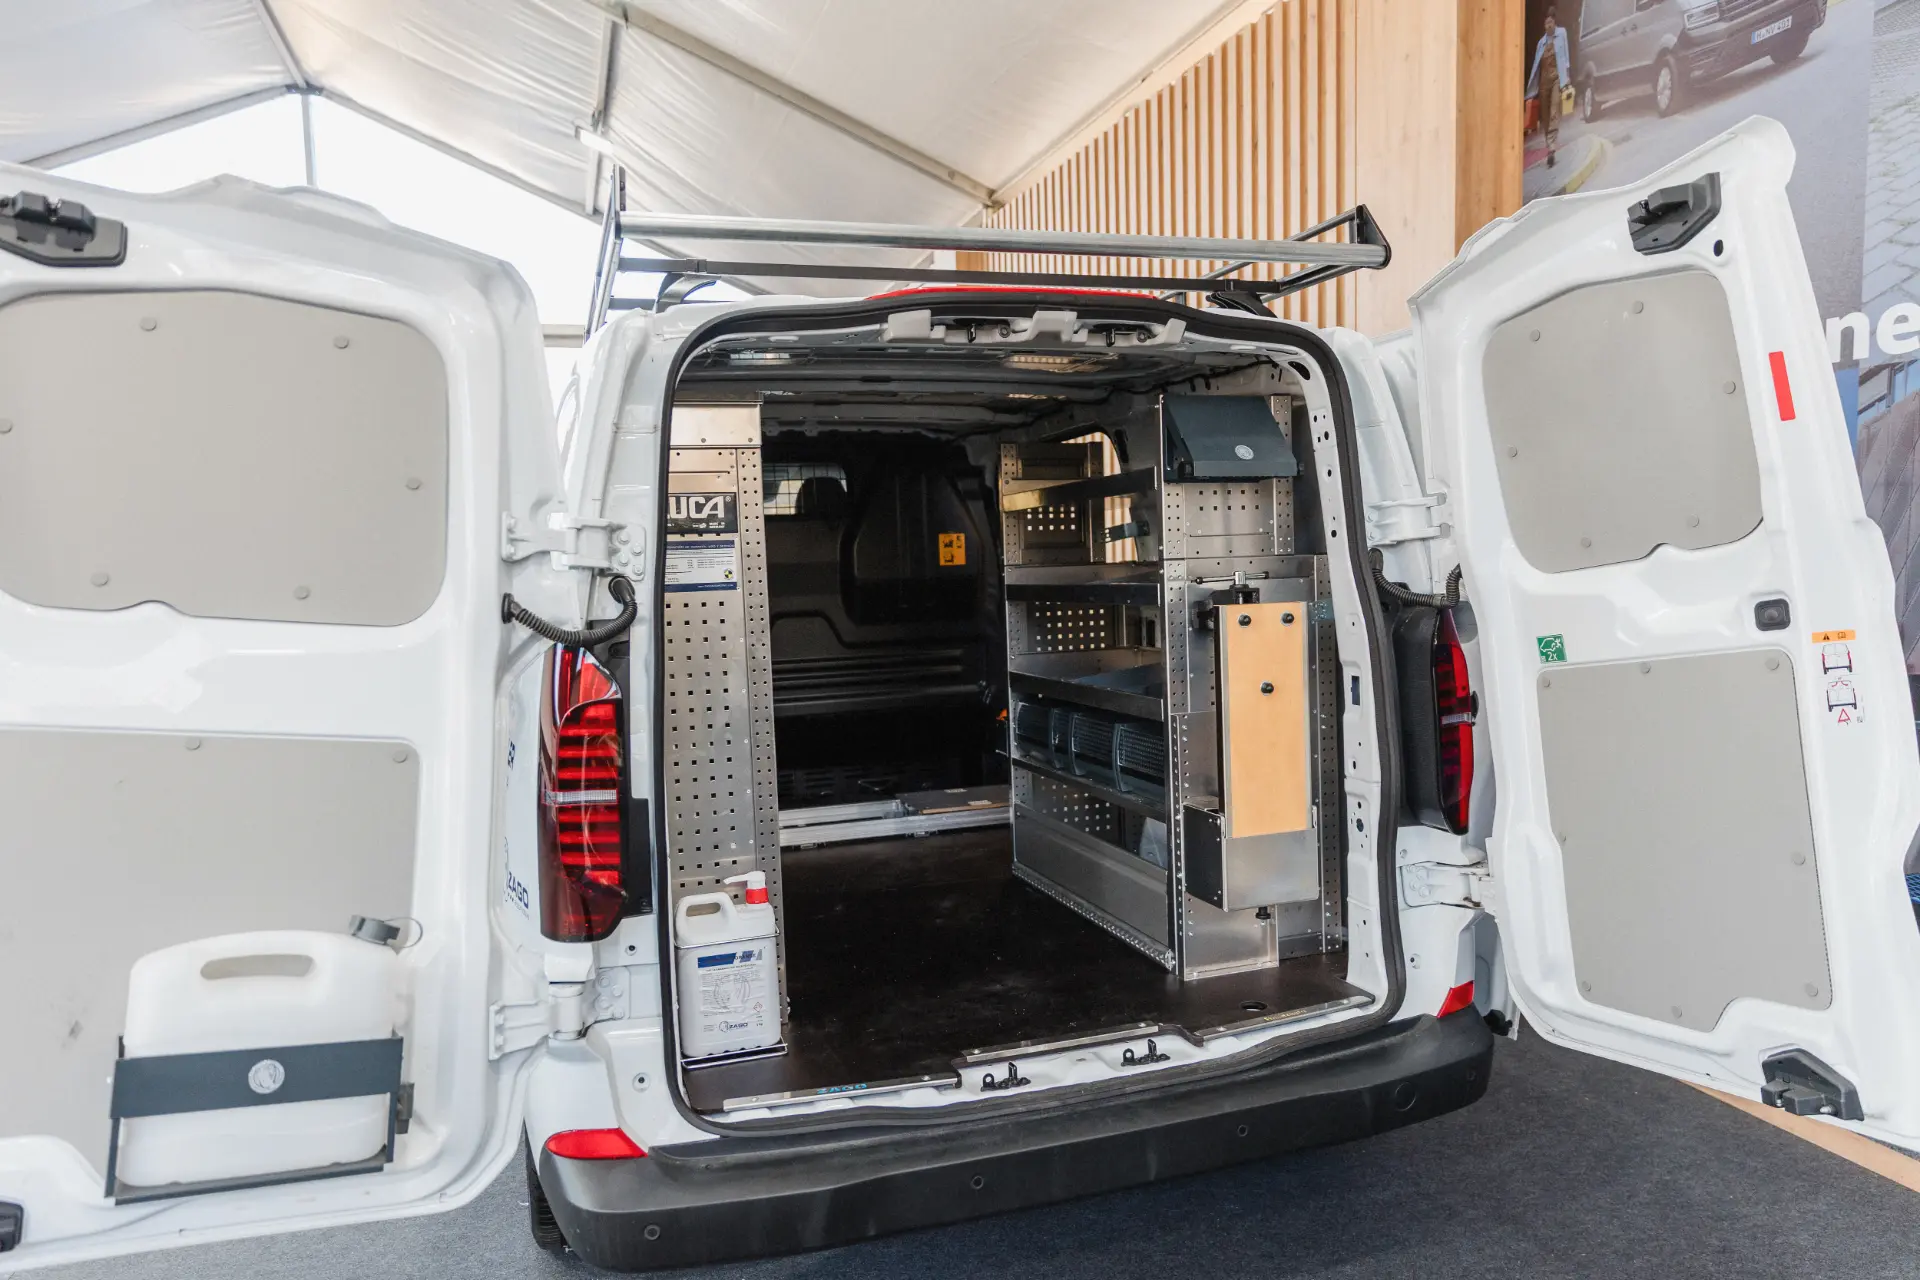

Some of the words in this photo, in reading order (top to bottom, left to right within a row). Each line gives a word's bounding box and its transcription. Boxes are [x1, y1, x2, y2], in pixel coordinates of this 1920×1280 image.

[1825, 302, 1920, 363] ne
[667, 496, 725, 519] UCA
[508, 870, 529, 909] ZAGO
